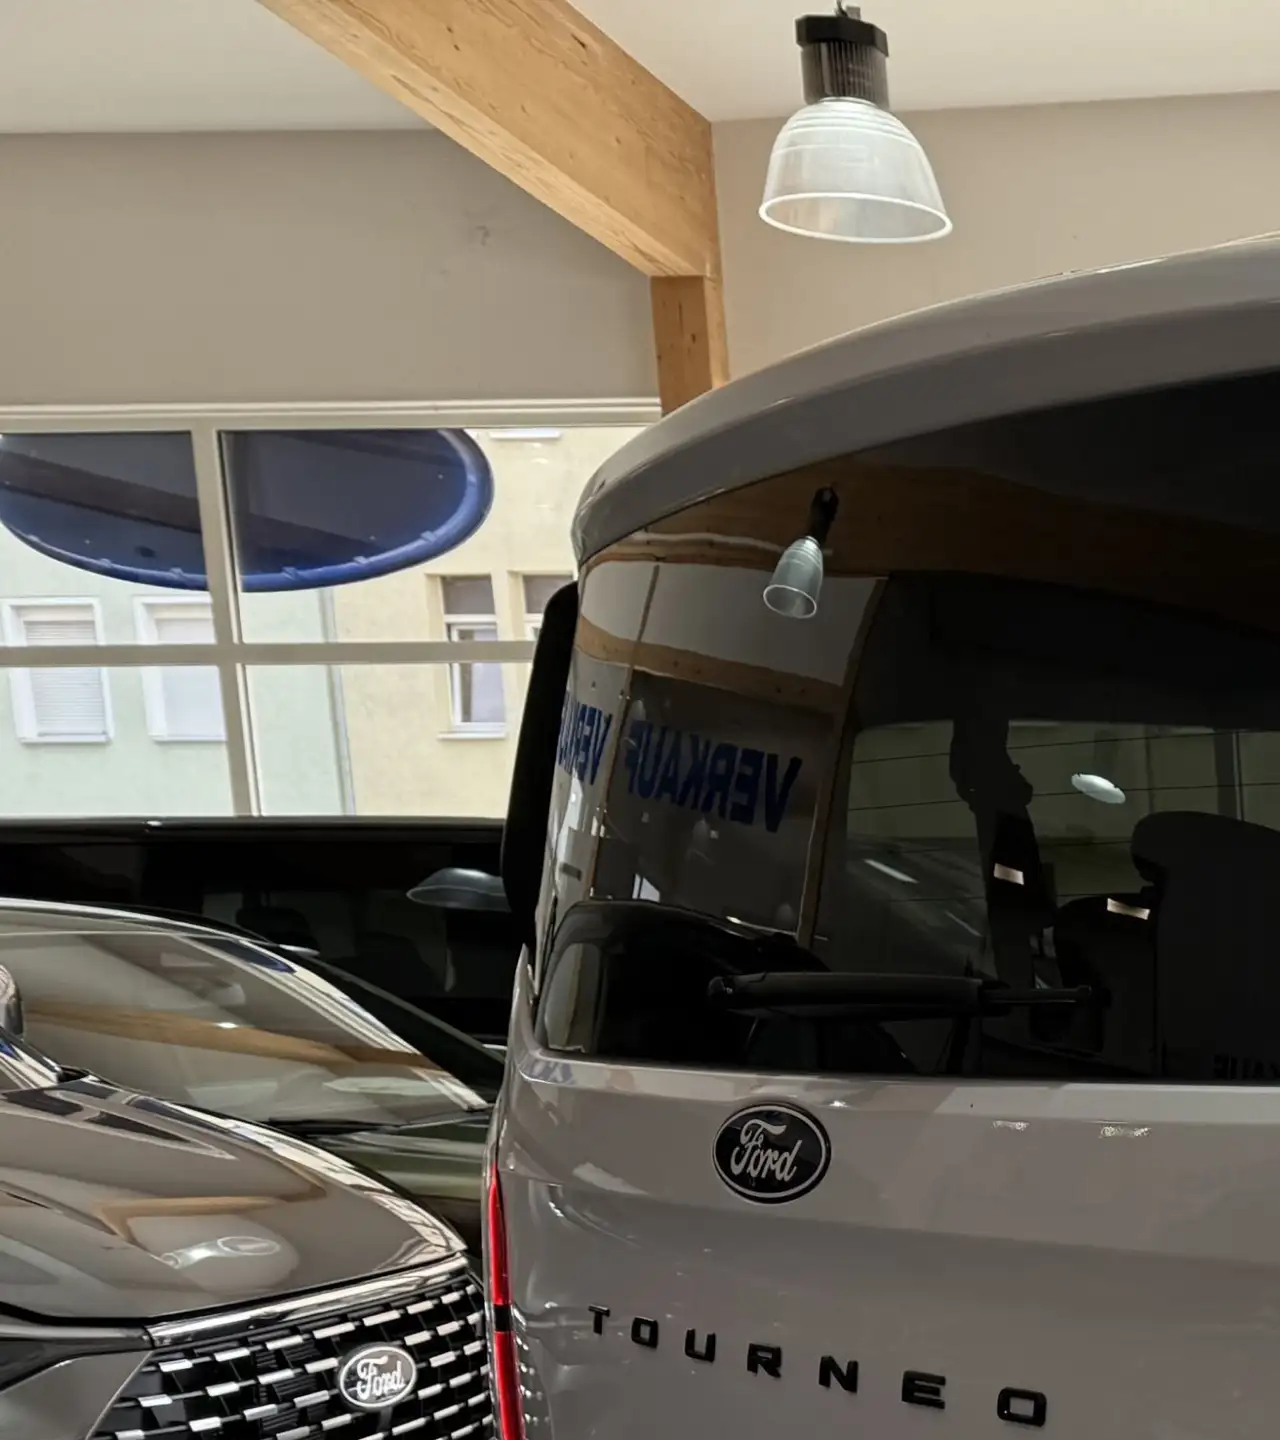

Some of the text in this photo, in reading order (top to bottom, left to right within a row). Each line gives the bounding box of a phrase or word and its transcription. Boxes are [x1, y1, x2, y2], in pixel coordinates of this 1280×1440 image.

[730, 1118, 802, 1182] Ford
[355, 1355, 406, 1400] Ford
[588, 1304, 1047, 1428] TOURNEO
